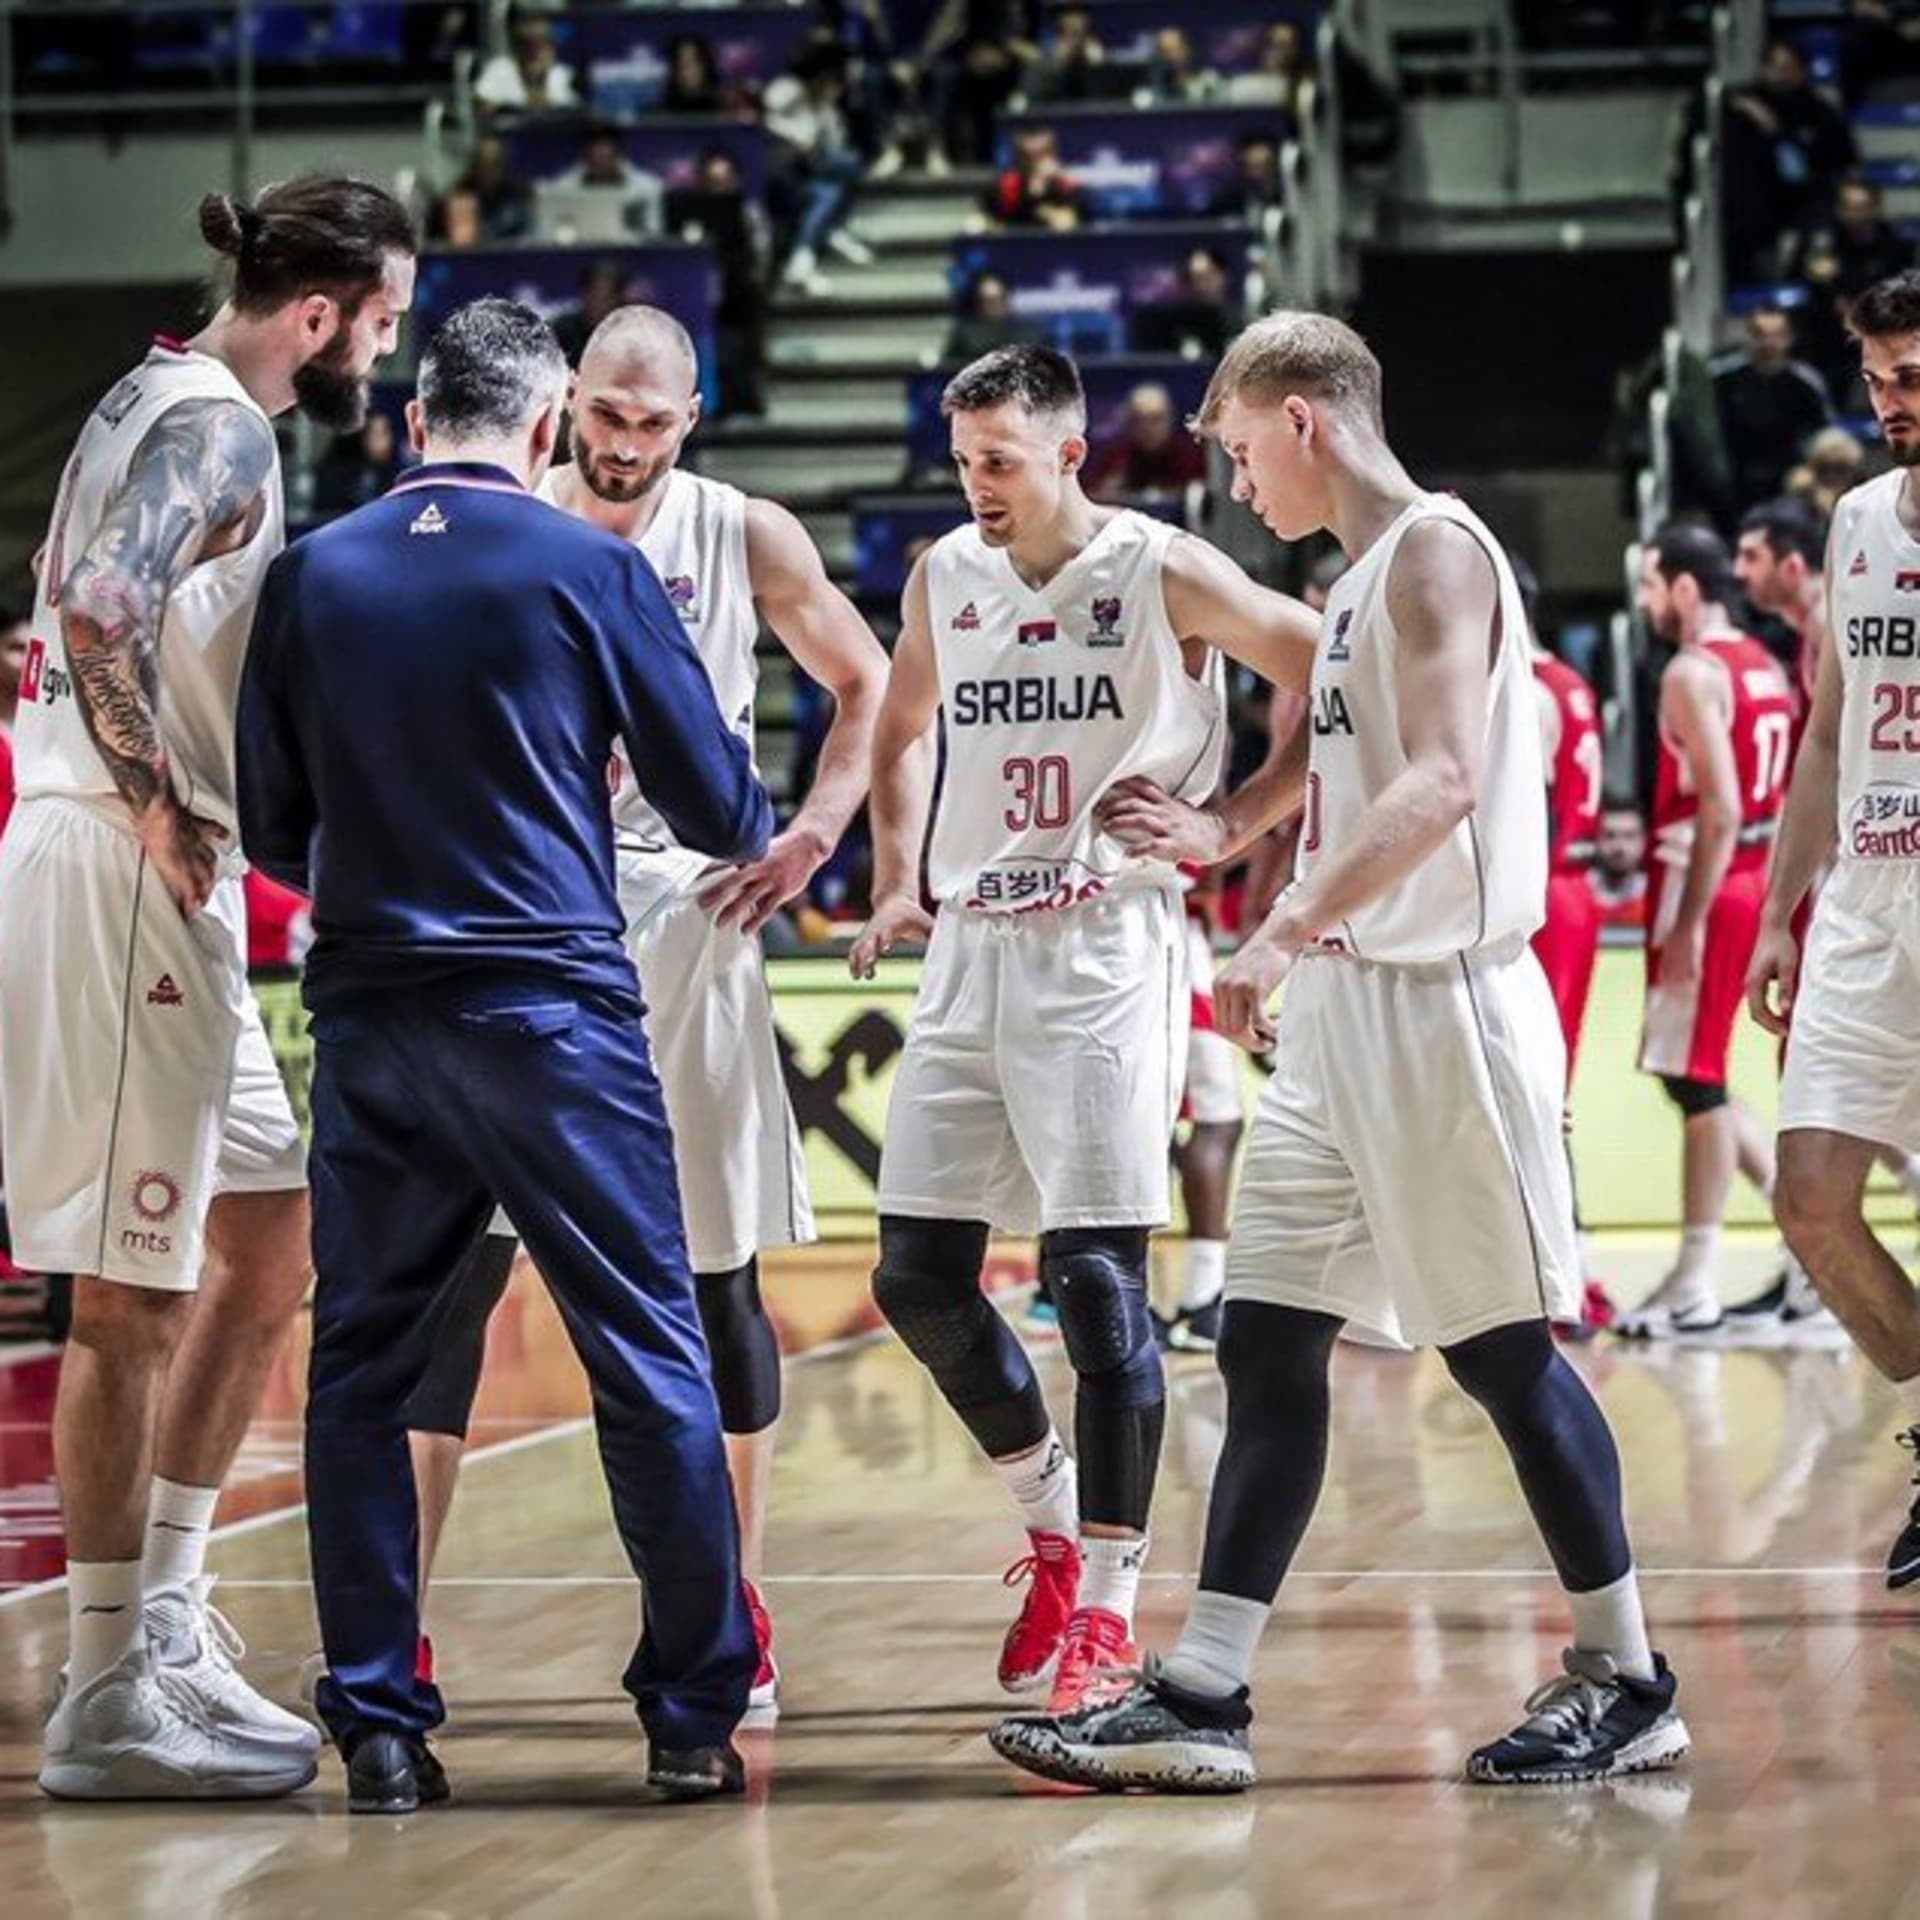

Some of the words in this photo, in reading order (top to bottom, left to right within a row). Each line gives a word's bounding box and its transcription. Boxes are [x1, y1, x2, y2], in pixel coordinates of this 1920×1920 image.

[1847, 616, 1920, 658] SRB
[954, 674, 1124, 725] SRBIJA
[1003, 755, 1069, 832] 30
[121, 1229, 171, 1254] mts
